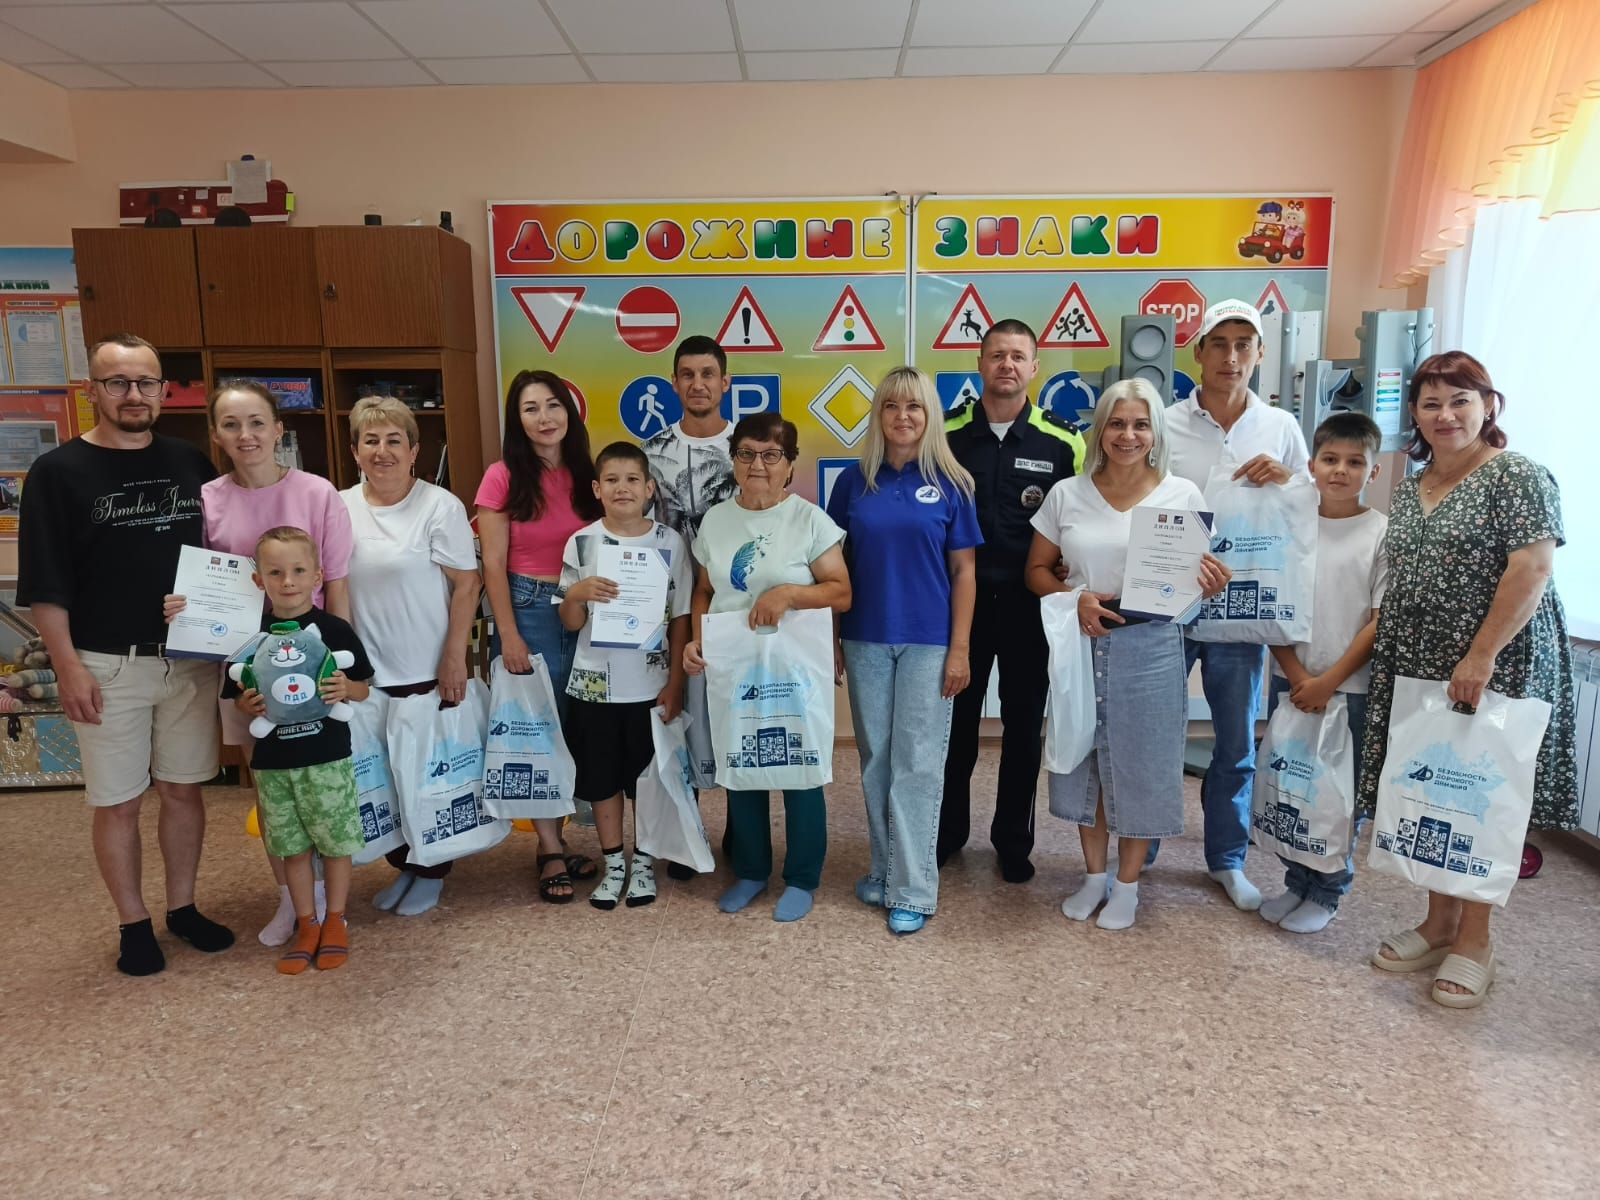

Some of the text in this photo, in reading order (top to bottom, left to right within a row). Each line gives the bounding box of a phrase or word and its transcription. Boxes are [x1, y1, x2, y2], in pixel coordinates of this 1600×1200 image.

[507, 214, 1161, 263] ДОРОЖНЫЕ ЗНАКИ
[1146, 304, 1200, 324] STOP
[731, 384, 770, 427] P
[91, 492, 156, 524] Timeless
[284, 692, 308, 702] ПДД
[276, 721, 323, 736] MINECRAFT
[352, 754, 379, 767] АСНОСТЬ
